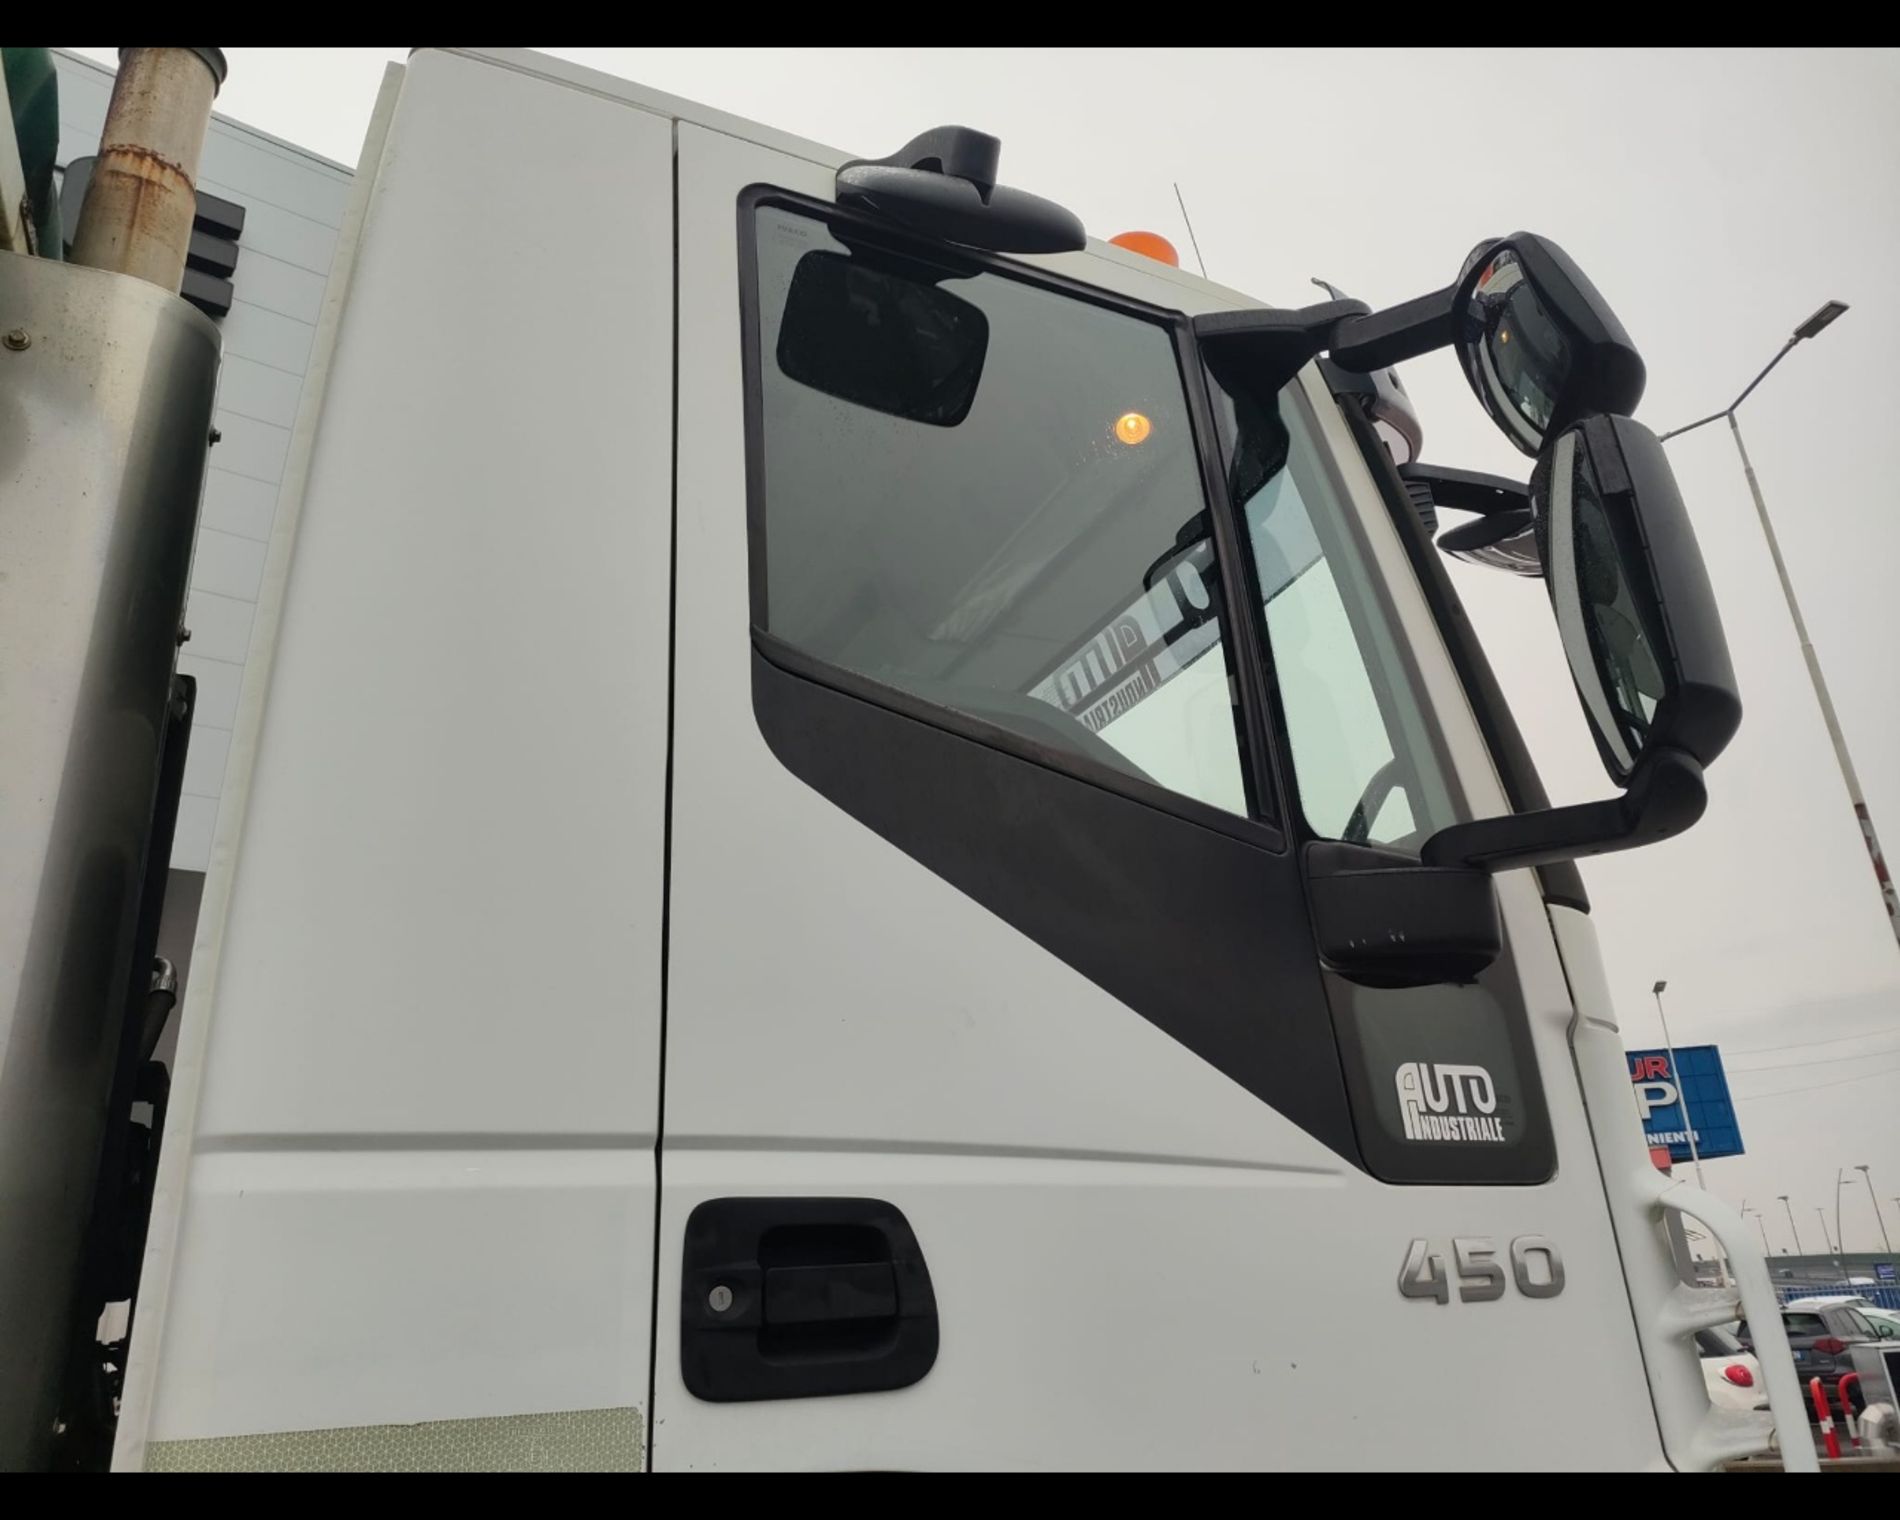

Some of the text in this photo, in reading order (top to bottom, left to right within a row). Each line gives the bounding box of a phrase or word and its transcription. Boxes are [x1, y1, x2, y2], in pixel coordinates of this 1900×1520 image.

[1395, 1062, 1497, 1115] AUTO
[1633, 1081, 1679, 1119] P
[1407, 1112, 1505, 1141] INDUSTRIALE
[1398, 1234, 1566, 1305] 450
